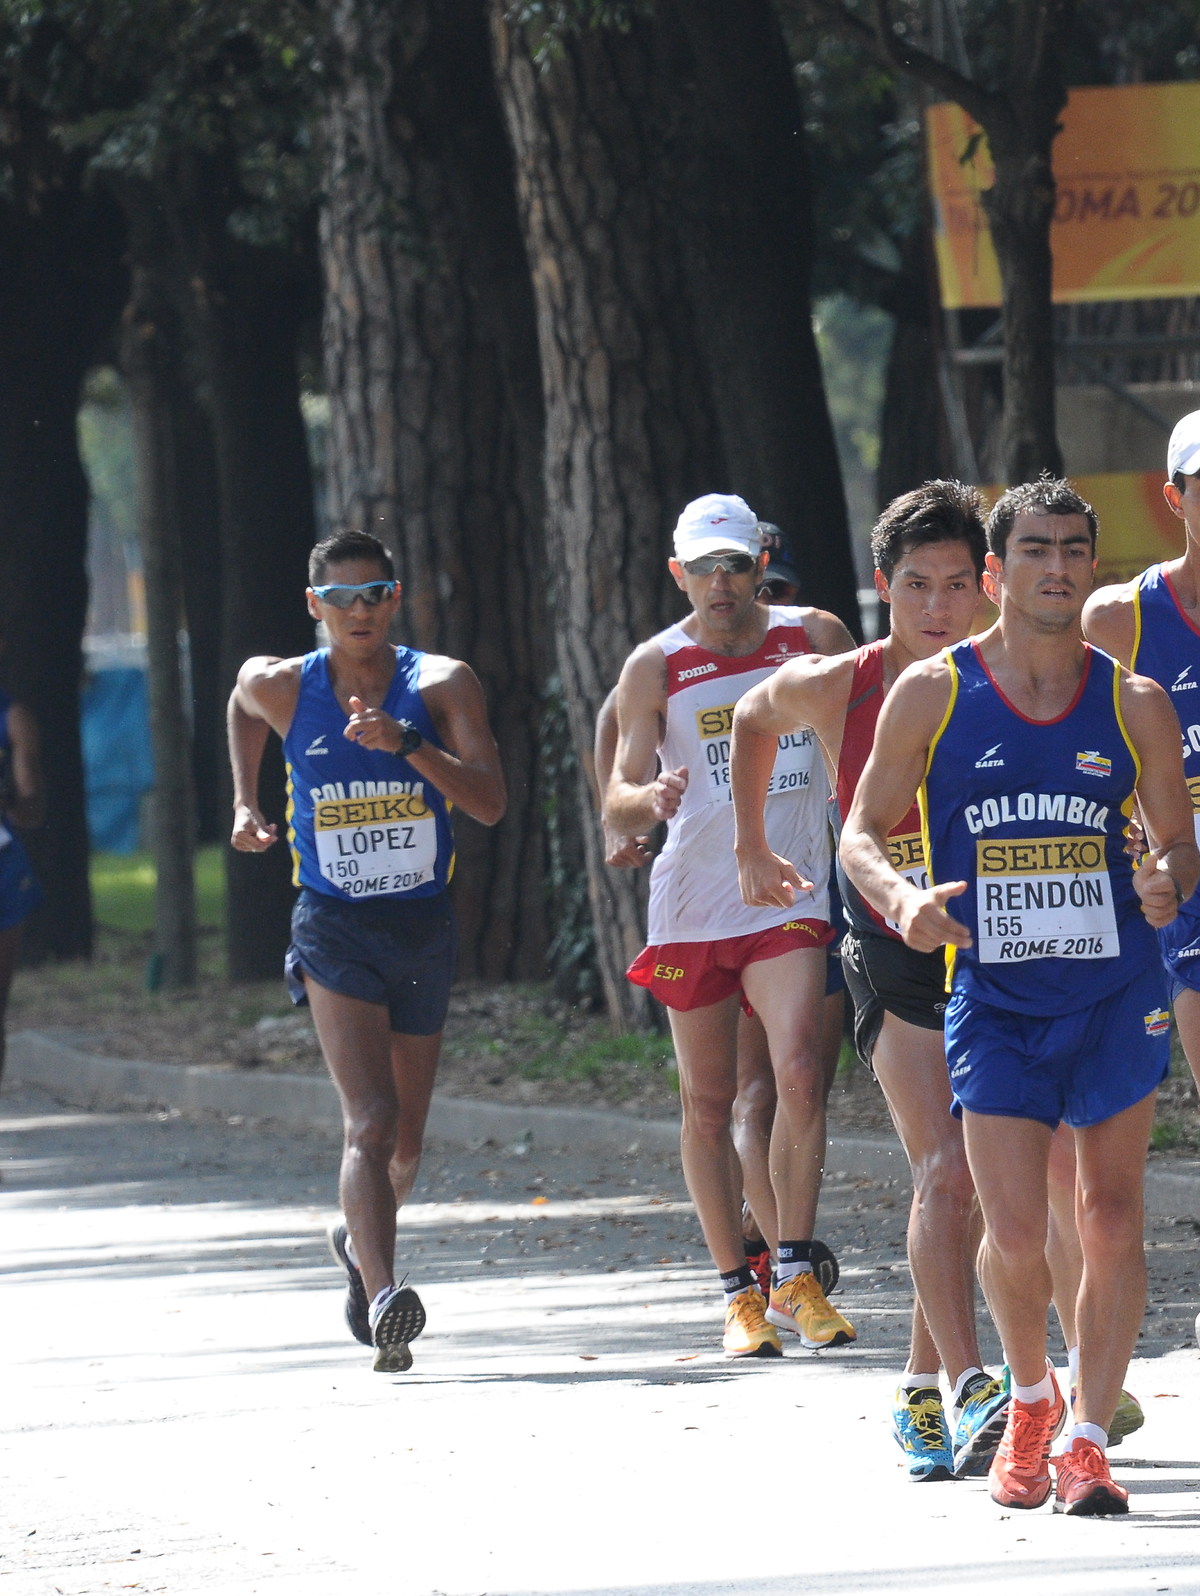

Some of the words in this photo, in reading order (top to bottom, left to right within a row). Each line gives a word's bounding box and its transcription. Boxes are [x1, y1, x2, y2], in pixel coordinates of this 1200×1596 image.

[1052, 186, 1141, 224] OMA
[1171, 681, 1198, 691] SAETA
[974, 758, 1004, 769] SAETA
[779, 771, 809, 790] 2016
[319, 796, 428, 828] SEIKO
[964, 792, 1109, 834] COLOMBIA
[337, 826, 416, 857] LÓPEZ
[982, 840, 1101, 872] SEIKO
[326, 859, 359, 878] 150
[342, 875, 390, 894] ROME
[985, 872, 1104, 911] RENDÓN
[983, 916, 1023, 937] 155
[999, 938, 1057, 959] ROME
[1059, 937, 1103, 955] 2016
[653, 963, 685, 981] ESP
